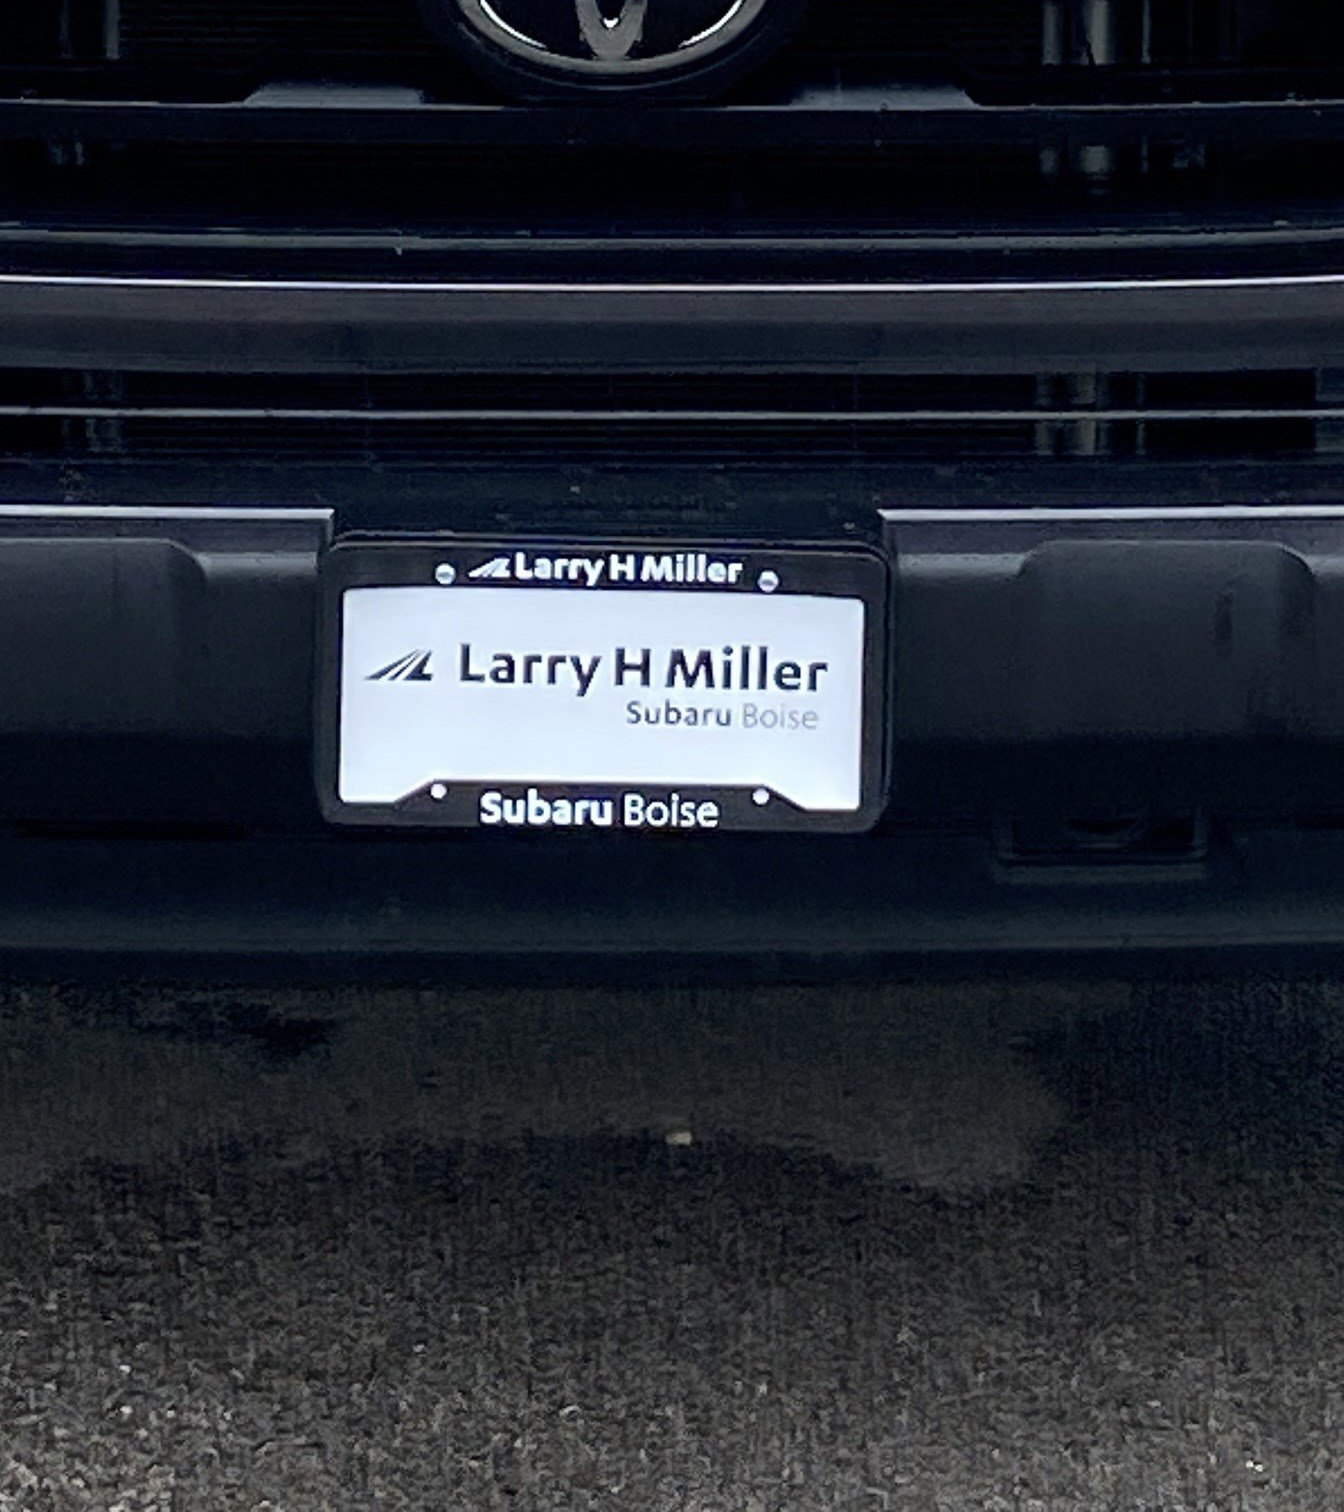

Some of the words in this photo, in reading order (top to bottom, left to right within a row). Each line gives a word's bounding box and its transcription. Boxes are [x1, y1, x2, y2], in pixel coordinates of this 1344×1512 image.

[515, 551, 605, 587] Larry
[610, 554, 635, 581] H
[640, 554, 743, 584] Miller
[459, 643, 602, 696] Larry
[613, 647, 651, 687] H
[664, 645, 828, 692] Miller
[626, 700, 733, 727] Subaru
[742, 703, 820, 730] Boise
[480, 788, 613, 826] Subaru
[624, 792, 719, 829] Boise
